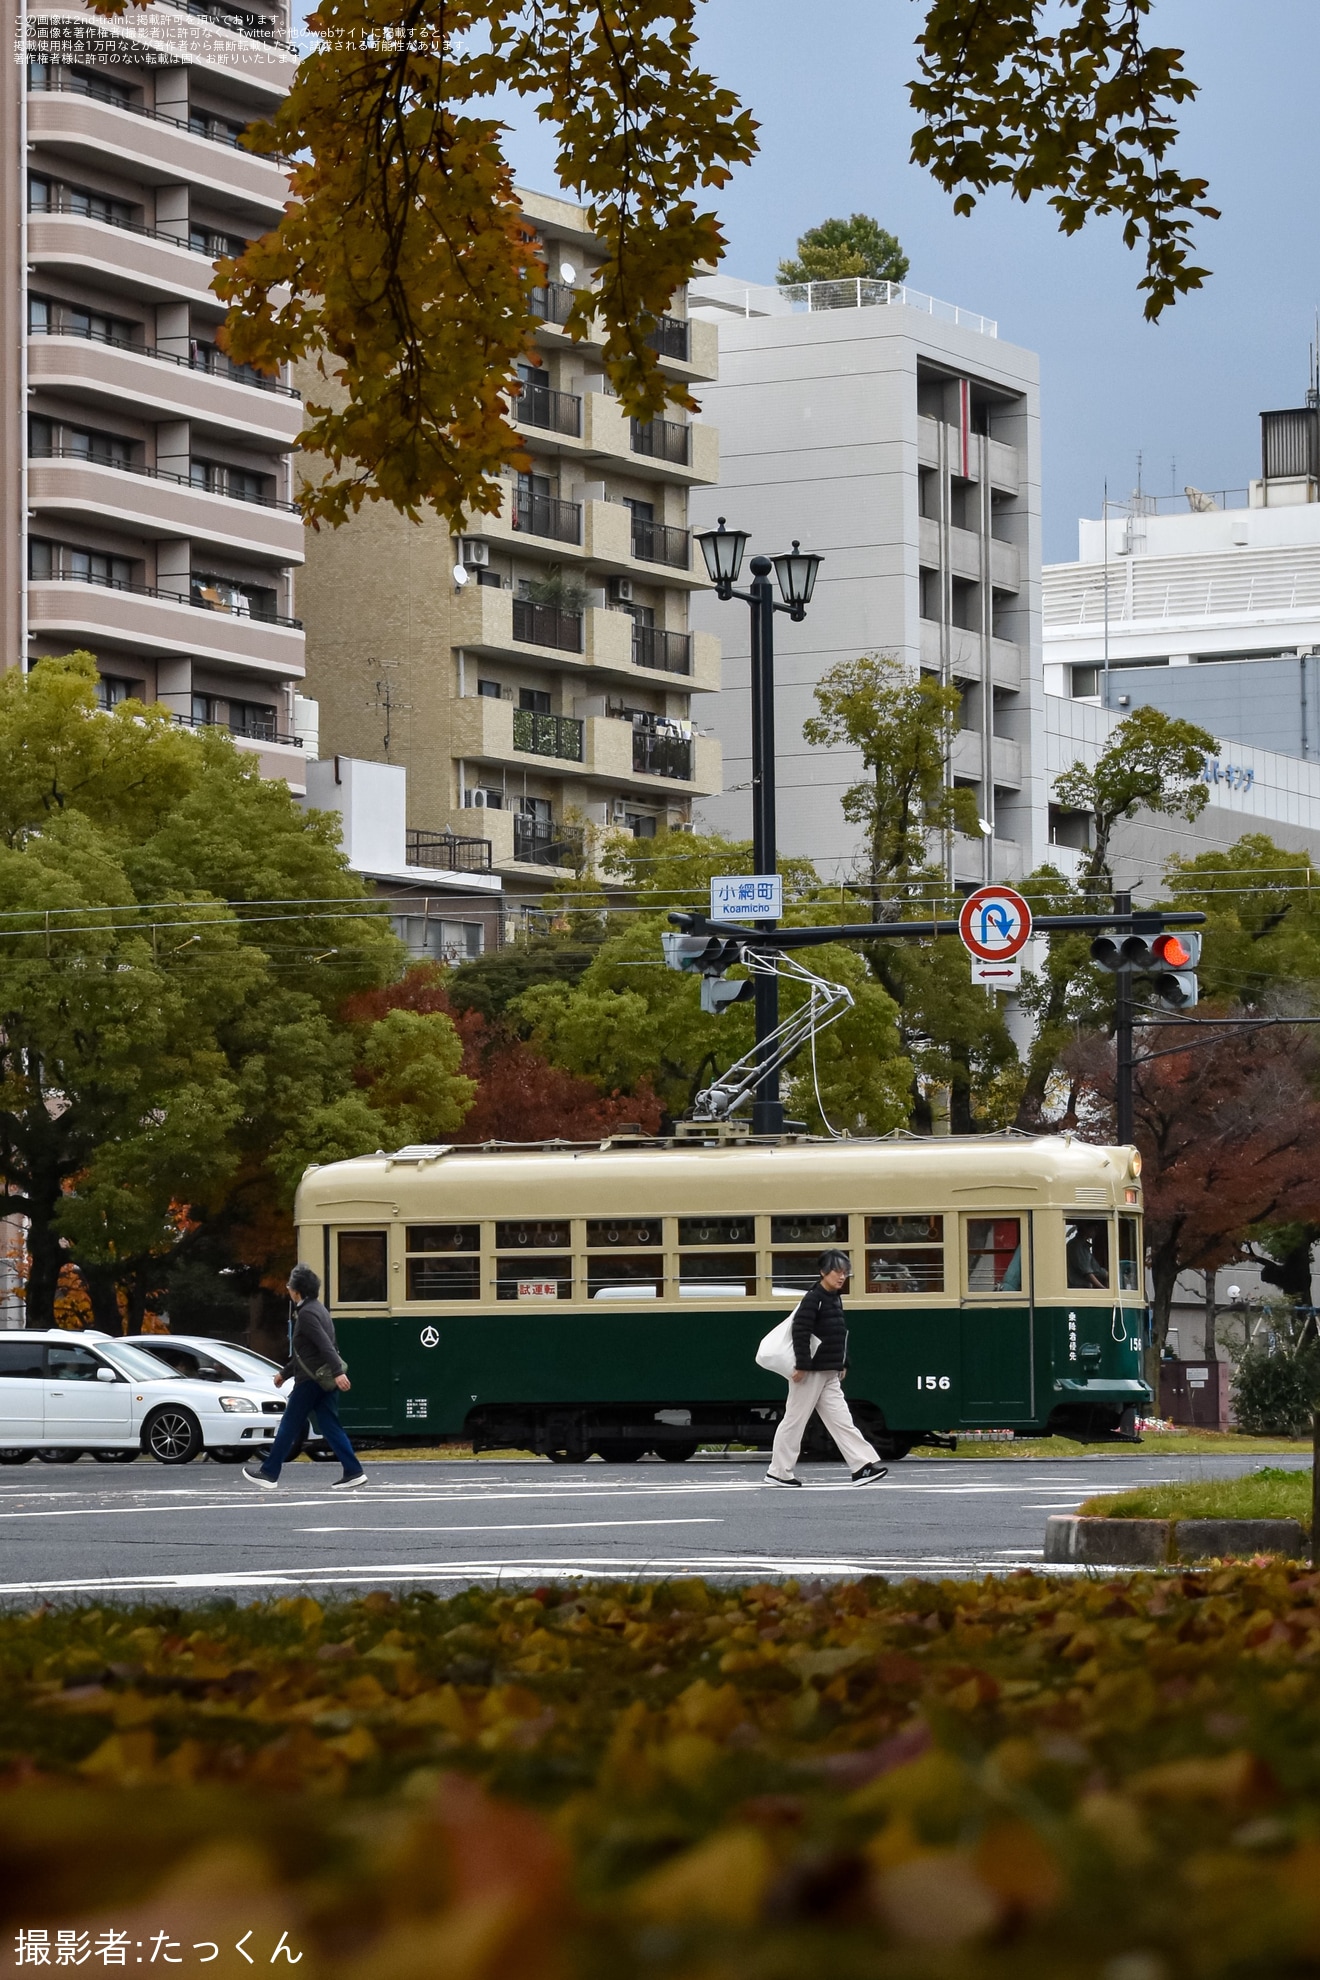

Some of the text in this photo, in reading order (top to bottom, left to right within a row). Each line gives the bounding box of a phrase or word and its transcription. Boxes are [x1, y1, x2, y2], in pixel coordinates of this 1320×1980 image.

[719, 883, 773, 901] 小網町
[723, 903, 770, 914] Koamicho
[519, 1284, 556, 1295] 試運転
[1130, 1337, 1142, 1351] 156
[917, 1376, 951, 1390] 156
